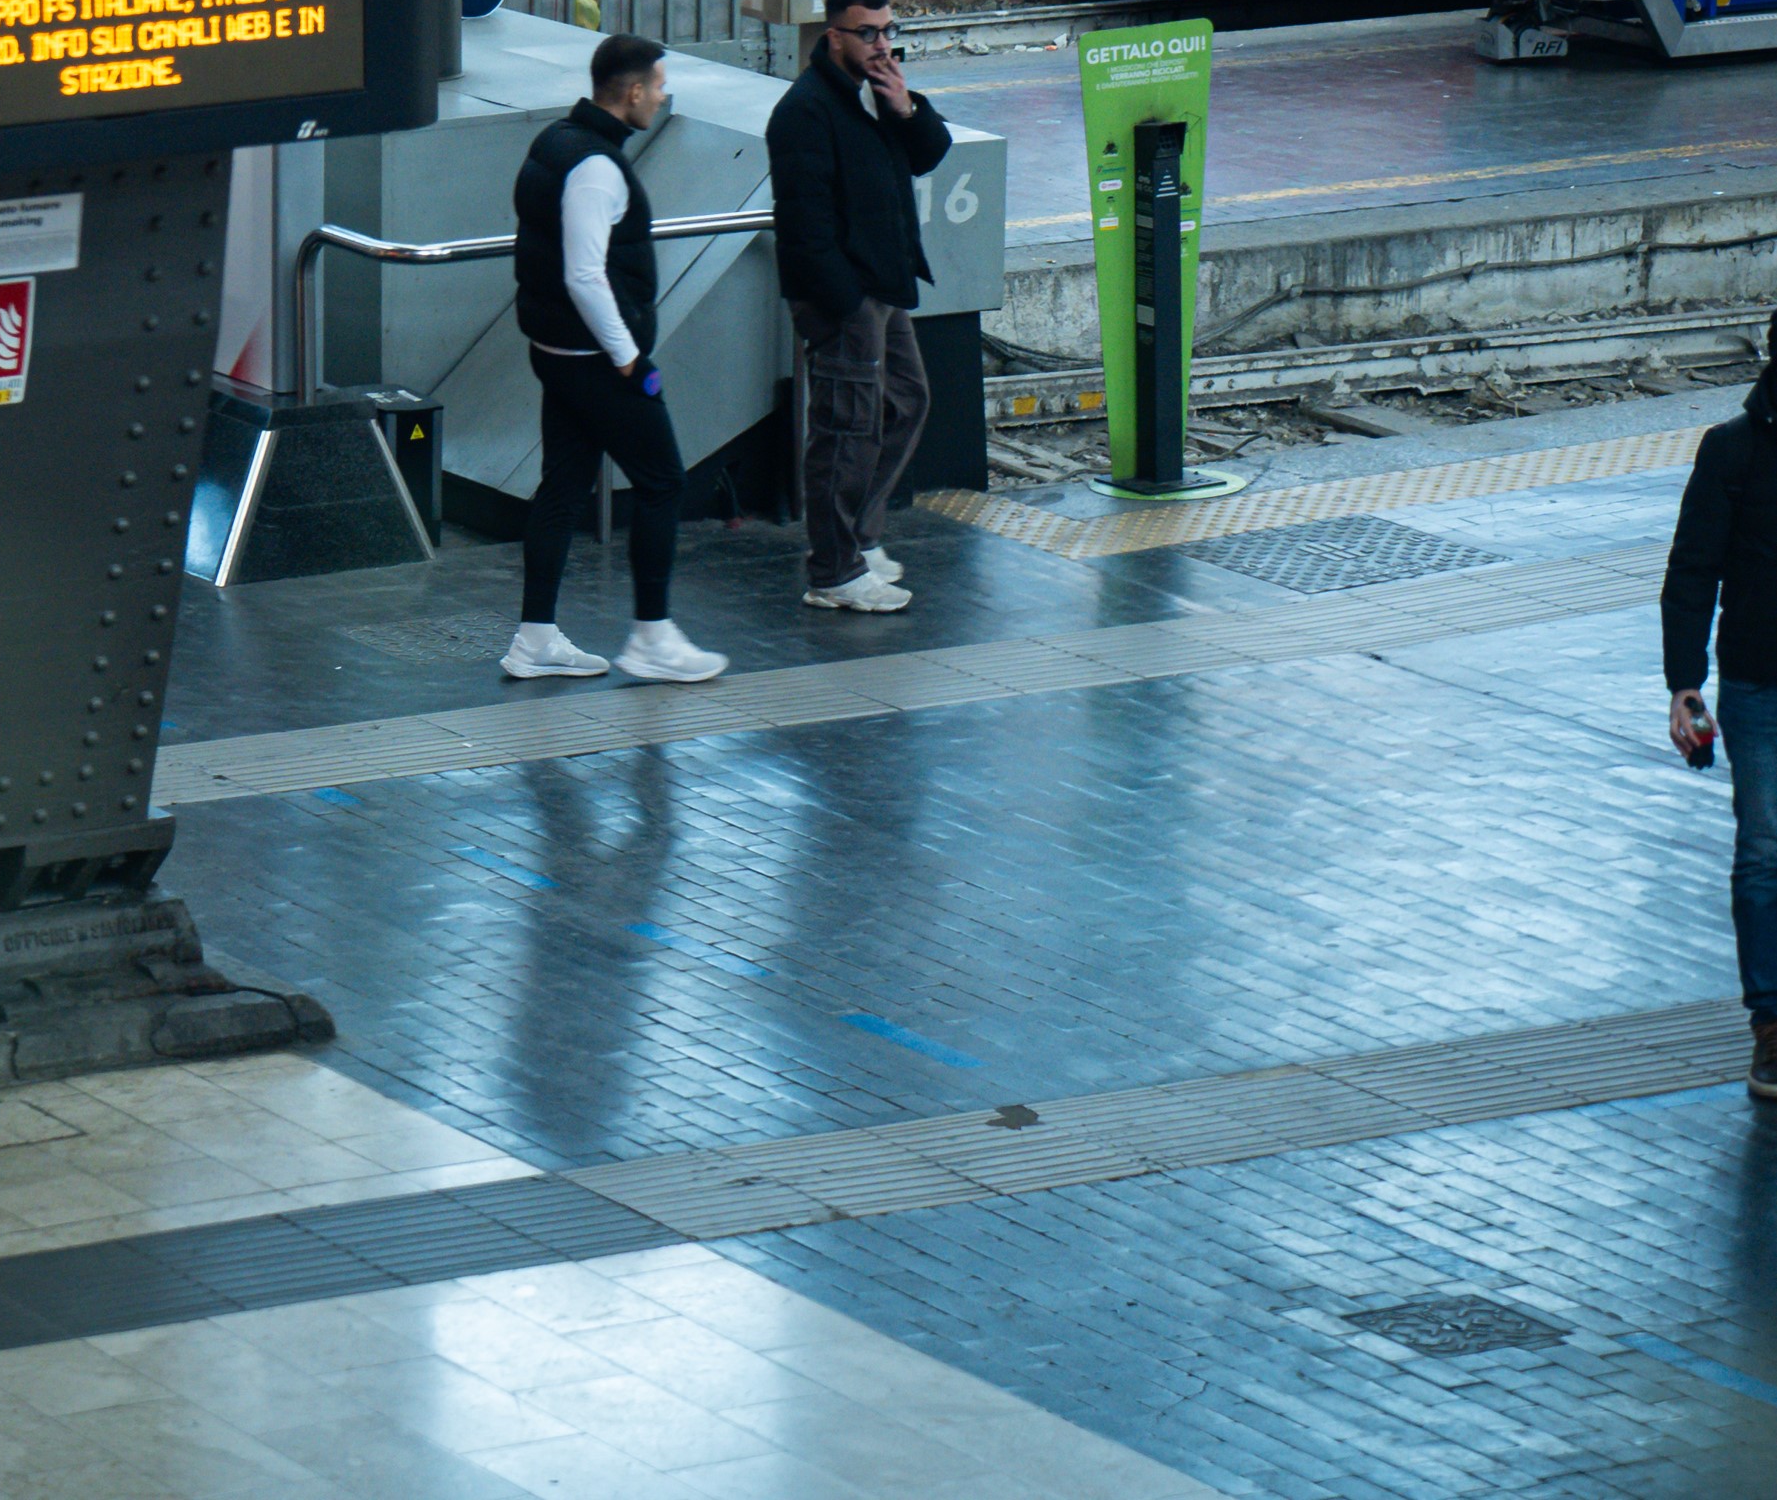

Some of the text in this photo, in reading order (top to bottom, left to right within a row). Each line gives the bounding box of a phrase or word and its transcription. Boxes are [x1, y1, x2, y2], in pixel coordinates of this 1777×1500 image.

[31, 28, 88, 62] INFO
[91, 24, 134, 55] SUI
[137, 15, 221, 51] CANALI
[226, 10, 272, 42] WEB
[275, 8, 292, 37] E
[298, 5, 324, 35] IN
[1532, 41, 1563, 55] RFI
[1086, 35, 1206, 65] GETTALO QUI!
[59, 56, 182, 96] STAZIONE.
[1110, 65, 1184, 81] VERRANNO RICICLATI
[19, 201, 61, 212] fumare
[915, 173, 979, 224] 16
